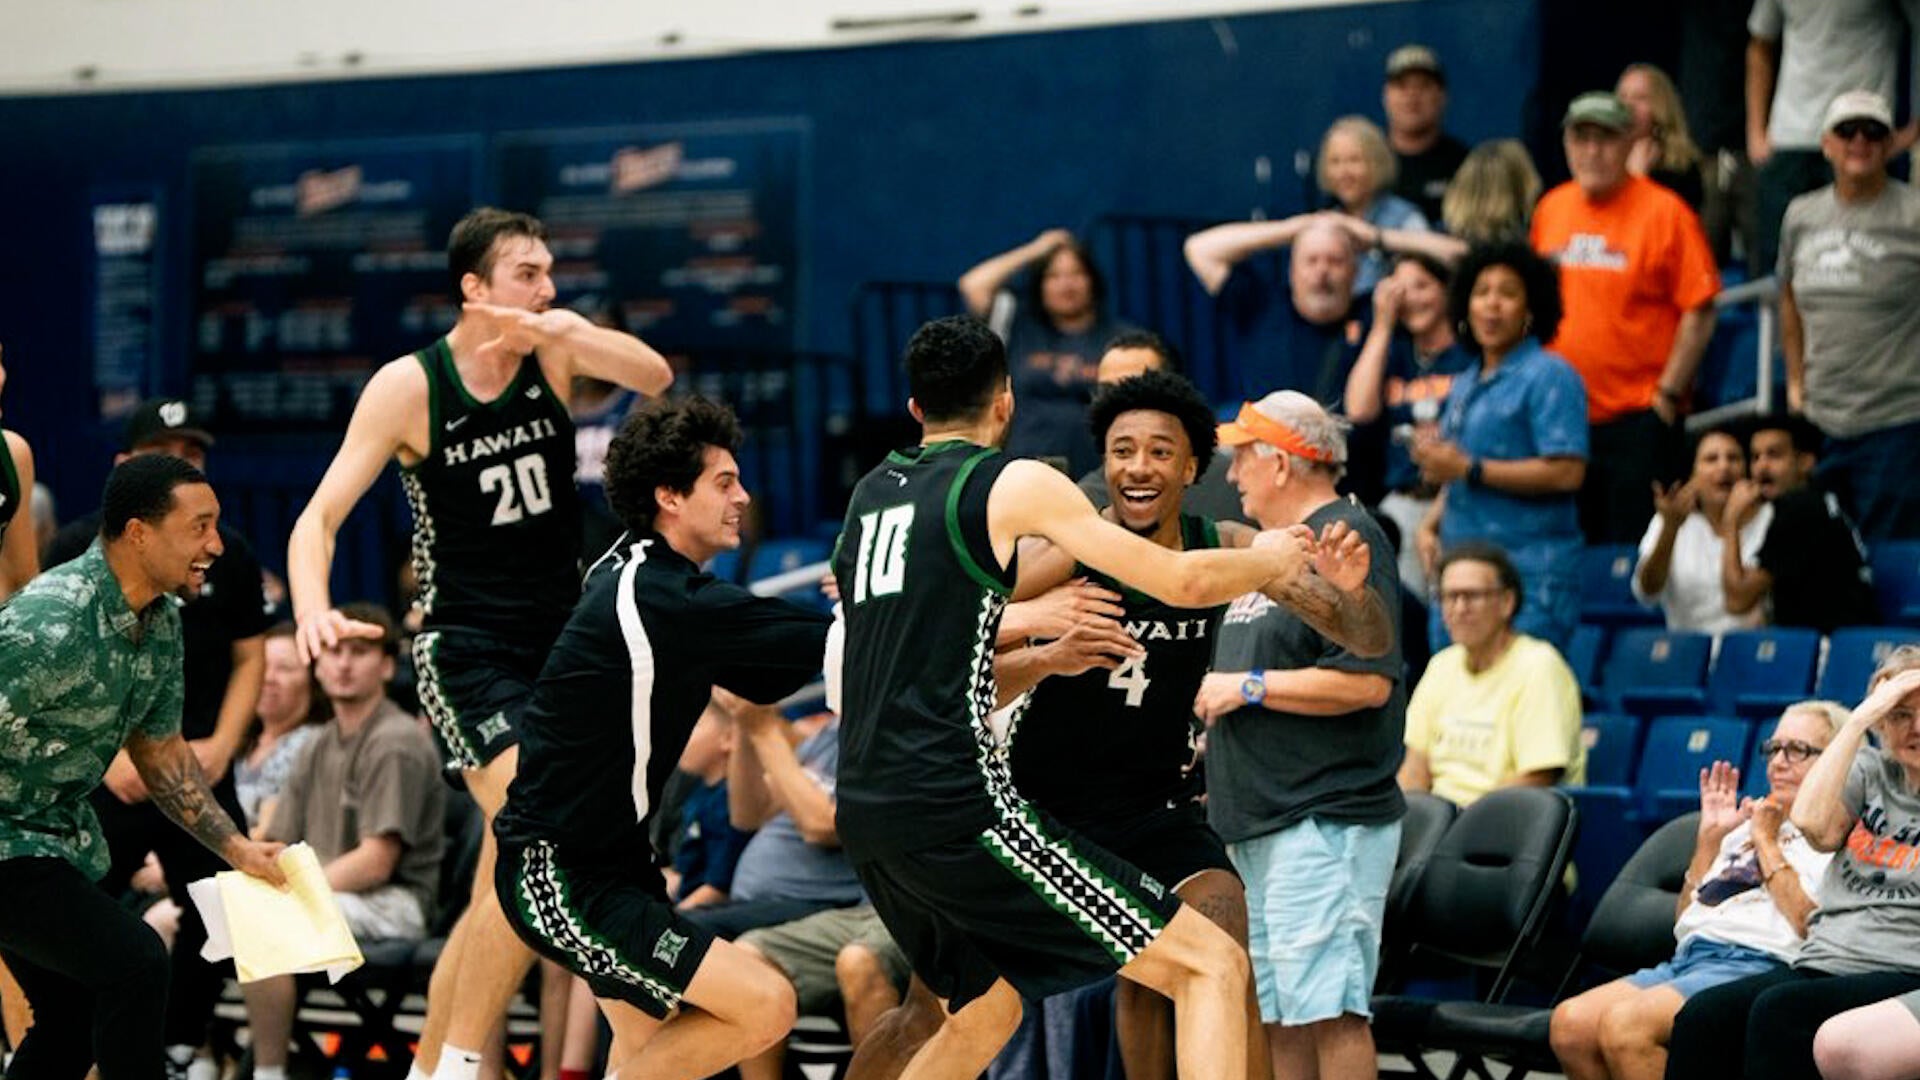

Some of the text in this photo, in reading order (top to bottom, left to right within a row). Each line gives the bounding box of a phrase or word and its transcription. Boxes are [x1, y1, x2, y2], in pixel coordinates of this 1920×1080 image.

[479, 452, 552, 526] 20
[854, 503, 915, 605] 10
[1107, 650, 1151, 707] 4
